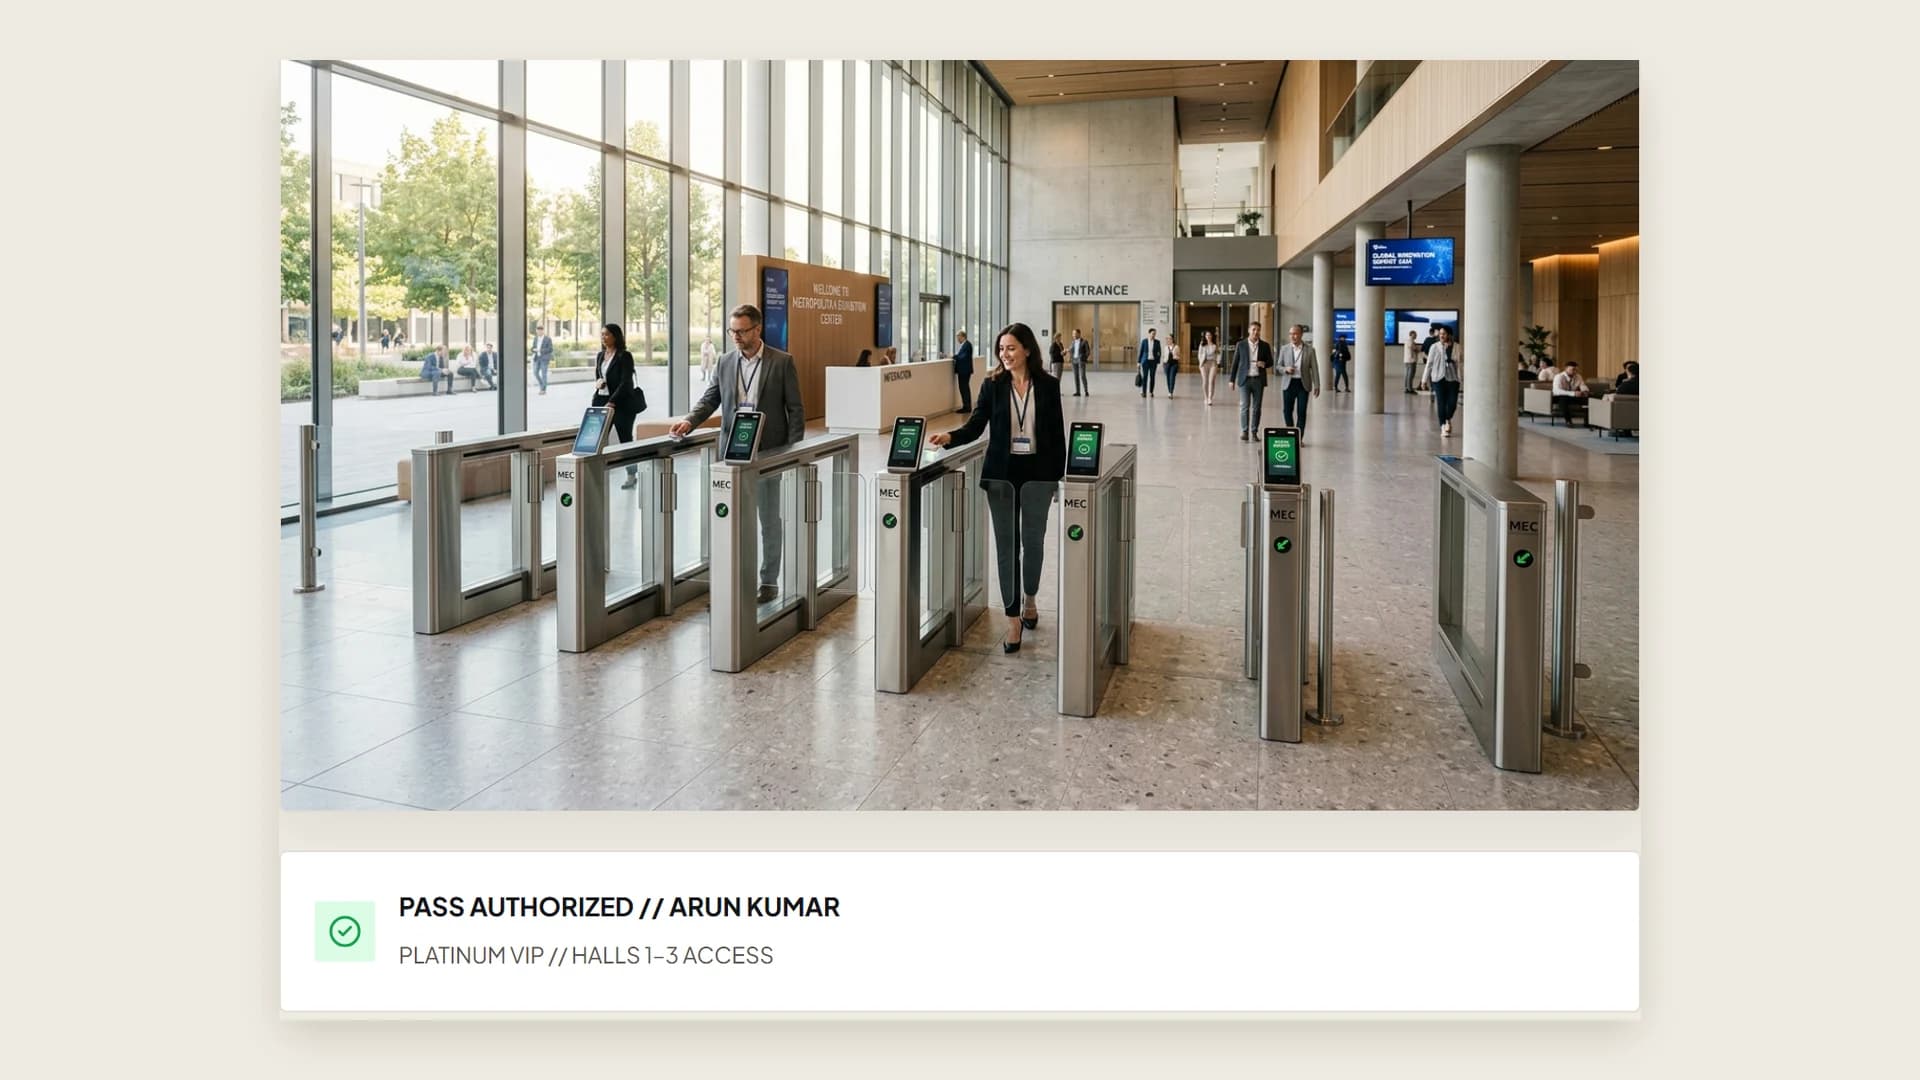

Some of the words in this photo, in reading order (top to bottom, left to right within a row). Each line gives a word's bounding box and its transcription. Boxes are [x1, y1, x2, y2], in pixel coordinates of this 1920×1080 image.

[1063, 285, 1129, 296] ENTRANCE
[1202, 284, 1236, 296] HALL
[1238, 284, 1249, 296] A
[557, 471, 575, 480] MEC
[712, 480, 731, 490] MEC
[879, 488, 900, 498] MEC
[1064, 499, 1087, 509] MEC
[1270, 509, 1296, 520] MEC
[1509, 520, 1539, 532] MEC
